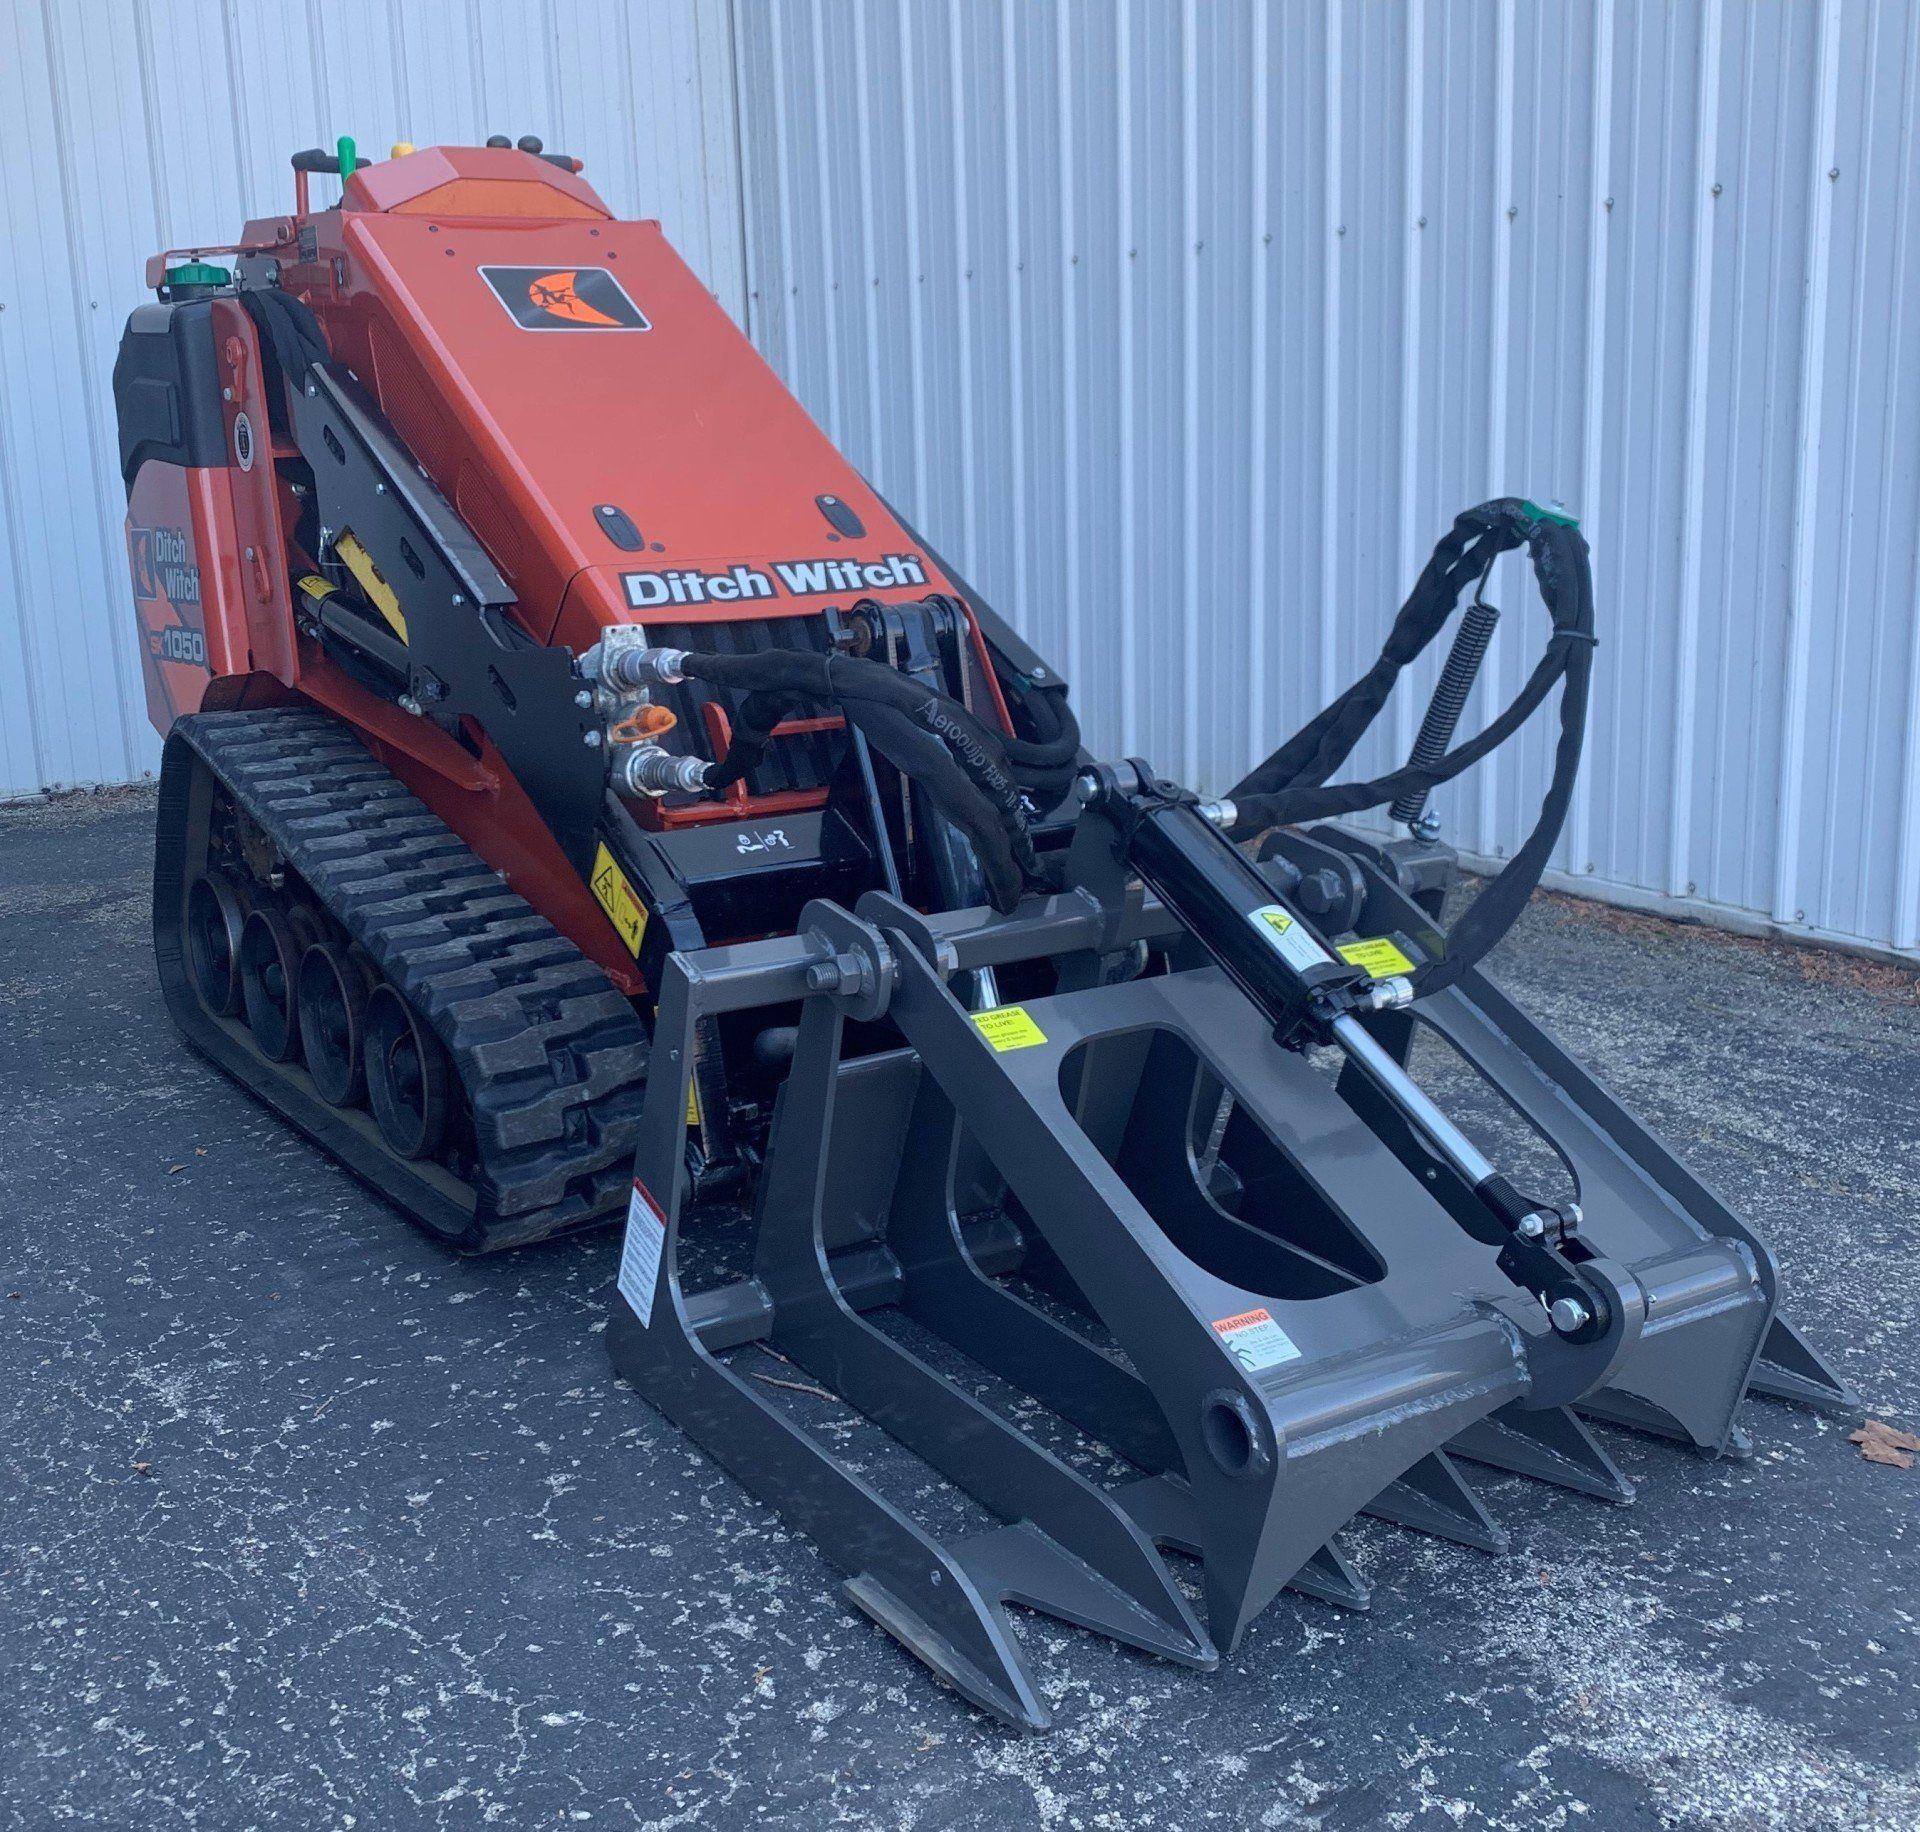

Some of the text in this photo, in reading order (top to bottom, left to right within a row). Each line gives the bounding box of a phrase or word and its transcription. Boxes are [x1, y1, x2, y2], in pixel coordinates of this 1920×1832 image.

[155, 531, 186, 563] Ditch
[165, 567, 199, 601] Witch
[625, 568, 773, 606] Ditch
[915, 698, 985, 767] Aeroquip
[1213, 1311, 1270, 1332] WARNING
[1249, 1323, 1269, 1334] STEP
